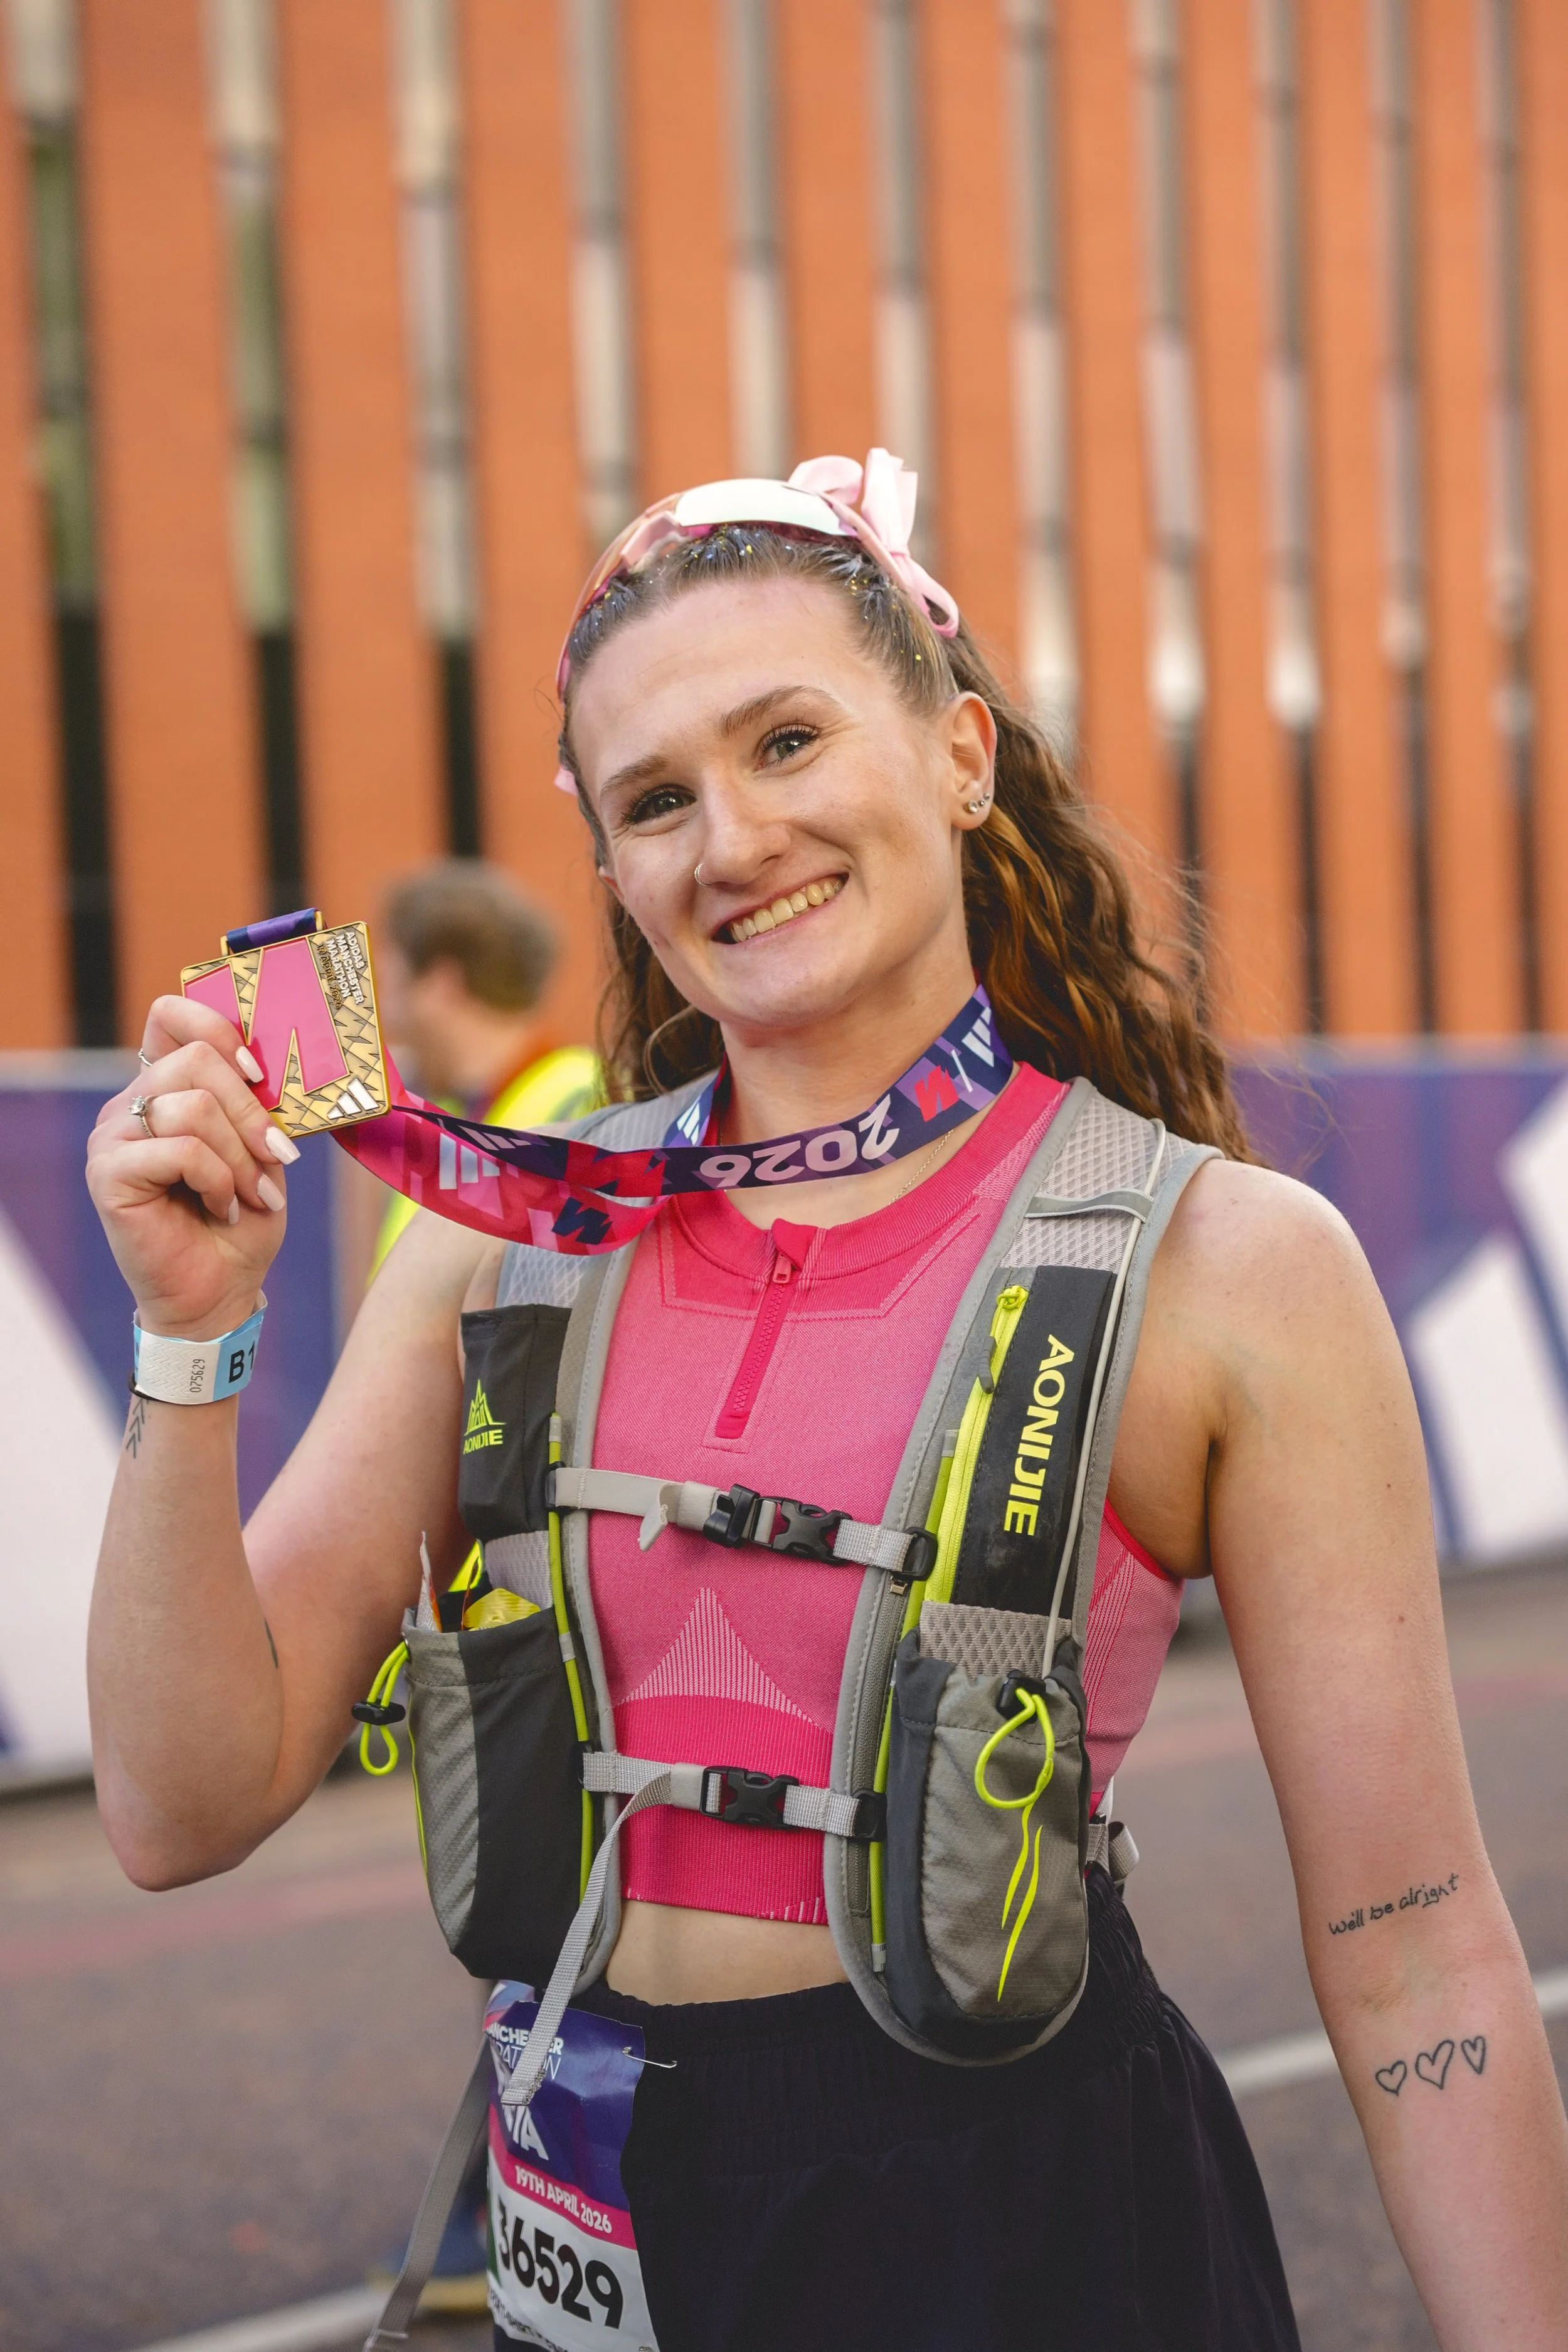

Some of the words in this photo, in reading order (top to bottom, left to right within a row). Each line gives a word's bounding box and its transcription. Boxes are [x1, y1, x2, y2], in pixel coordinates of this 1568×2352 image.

[317, 943, 327, 955] 19
[320, 956, 334, 984] APRIL
[326, 938, 351, 999] MARATHON
[336, 934, 364, 1005] MANCHESTER
[346, 931, 364, 969] ADIDAS
[330, 985, 342, 1009] 2026
[700, 1094, 900, 1187] 2026
[189, 1359, 206, 1393] 075629
[464, 1429, 503, 1454] AONIJIE
[1004, 1334, 1074, 1536] AONIJIE
[1370, 1903, 1394, 1920] be
[1399, 1873, 1459, 1909] alright
[515, 2165, 545, 2197] 19TH
[547, 2182, 580, 2218] APRIL
[581, 2202, 613, 2234] 2026
[498, 2194, 624, 2330] 36529
